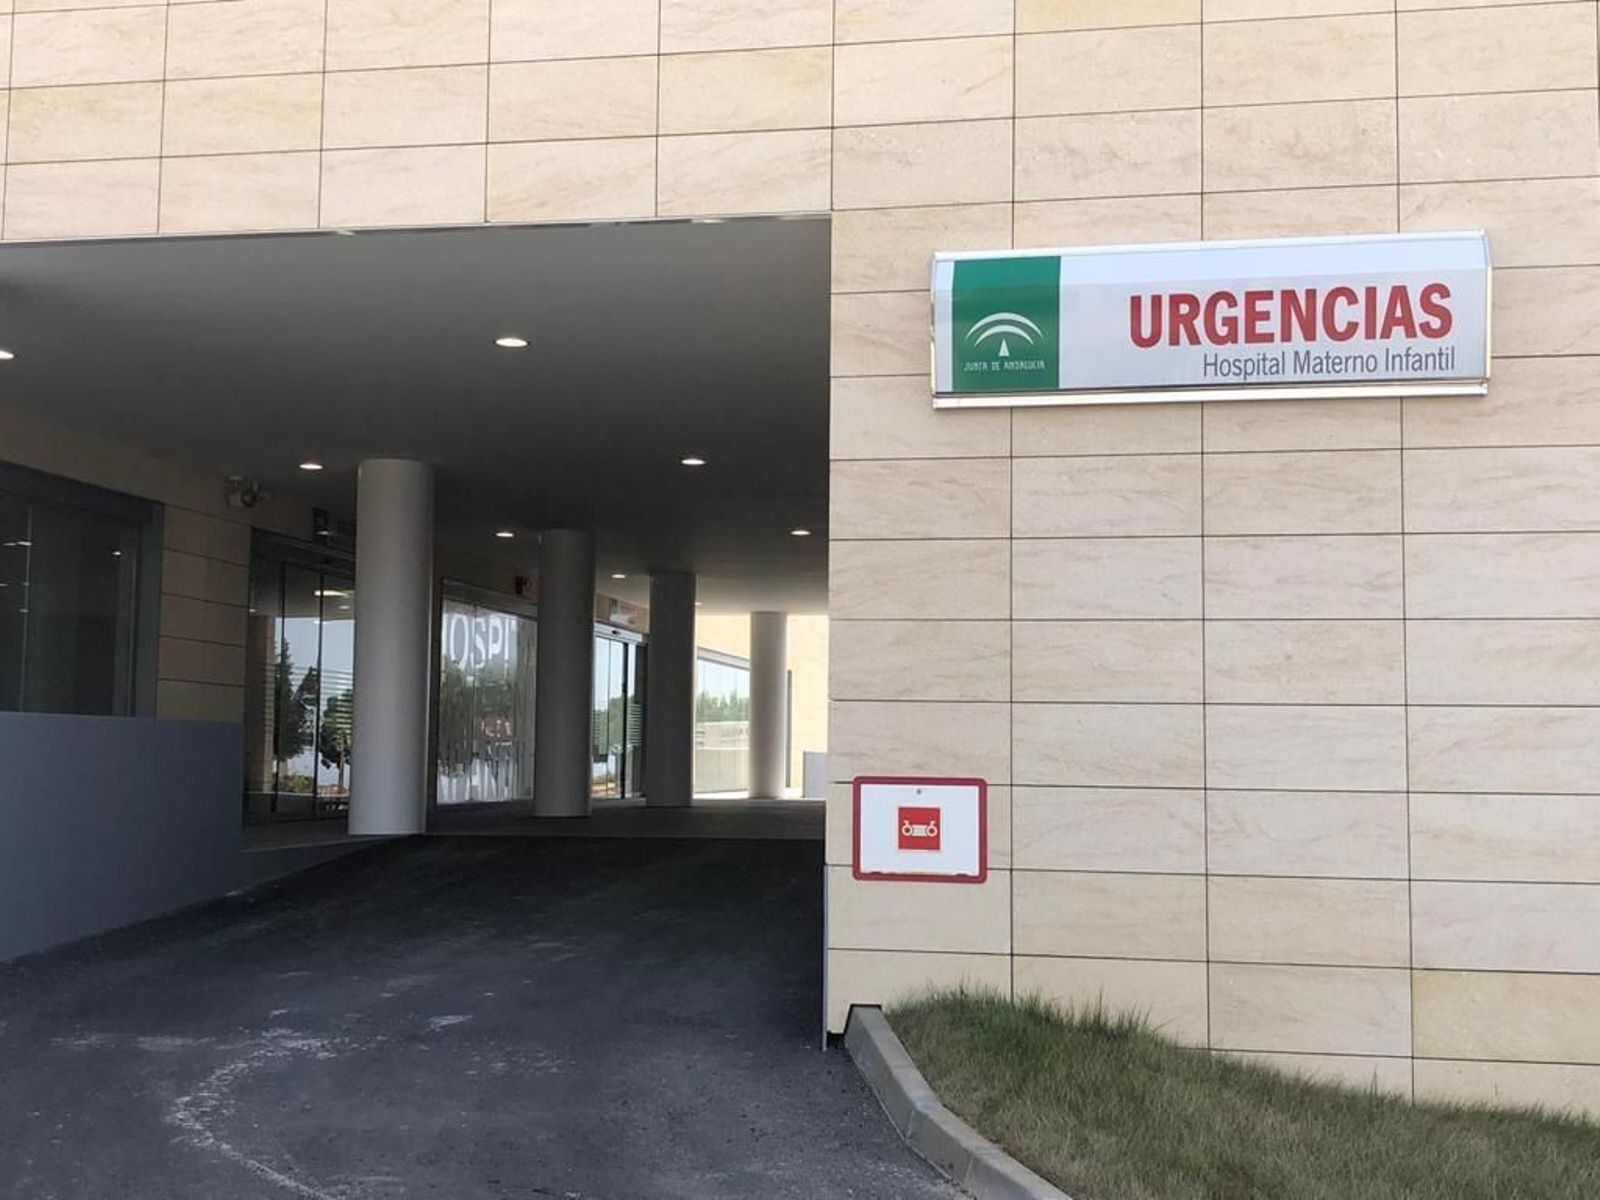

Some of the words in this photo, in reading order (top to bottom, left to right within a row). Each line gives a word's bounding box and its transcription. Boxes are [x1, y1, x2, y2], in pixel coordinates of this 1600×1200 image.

[1130, 283, 1453, 348] URGENCIAS
[964, 361, 988, 371] JUNTA
[991, 361, 1001, 371] DE
[1203, 351, 1285, 381] Hospital
[1293, 349, 1378, 375] Materno
[1385, 346, 1455, 372] Infantil
